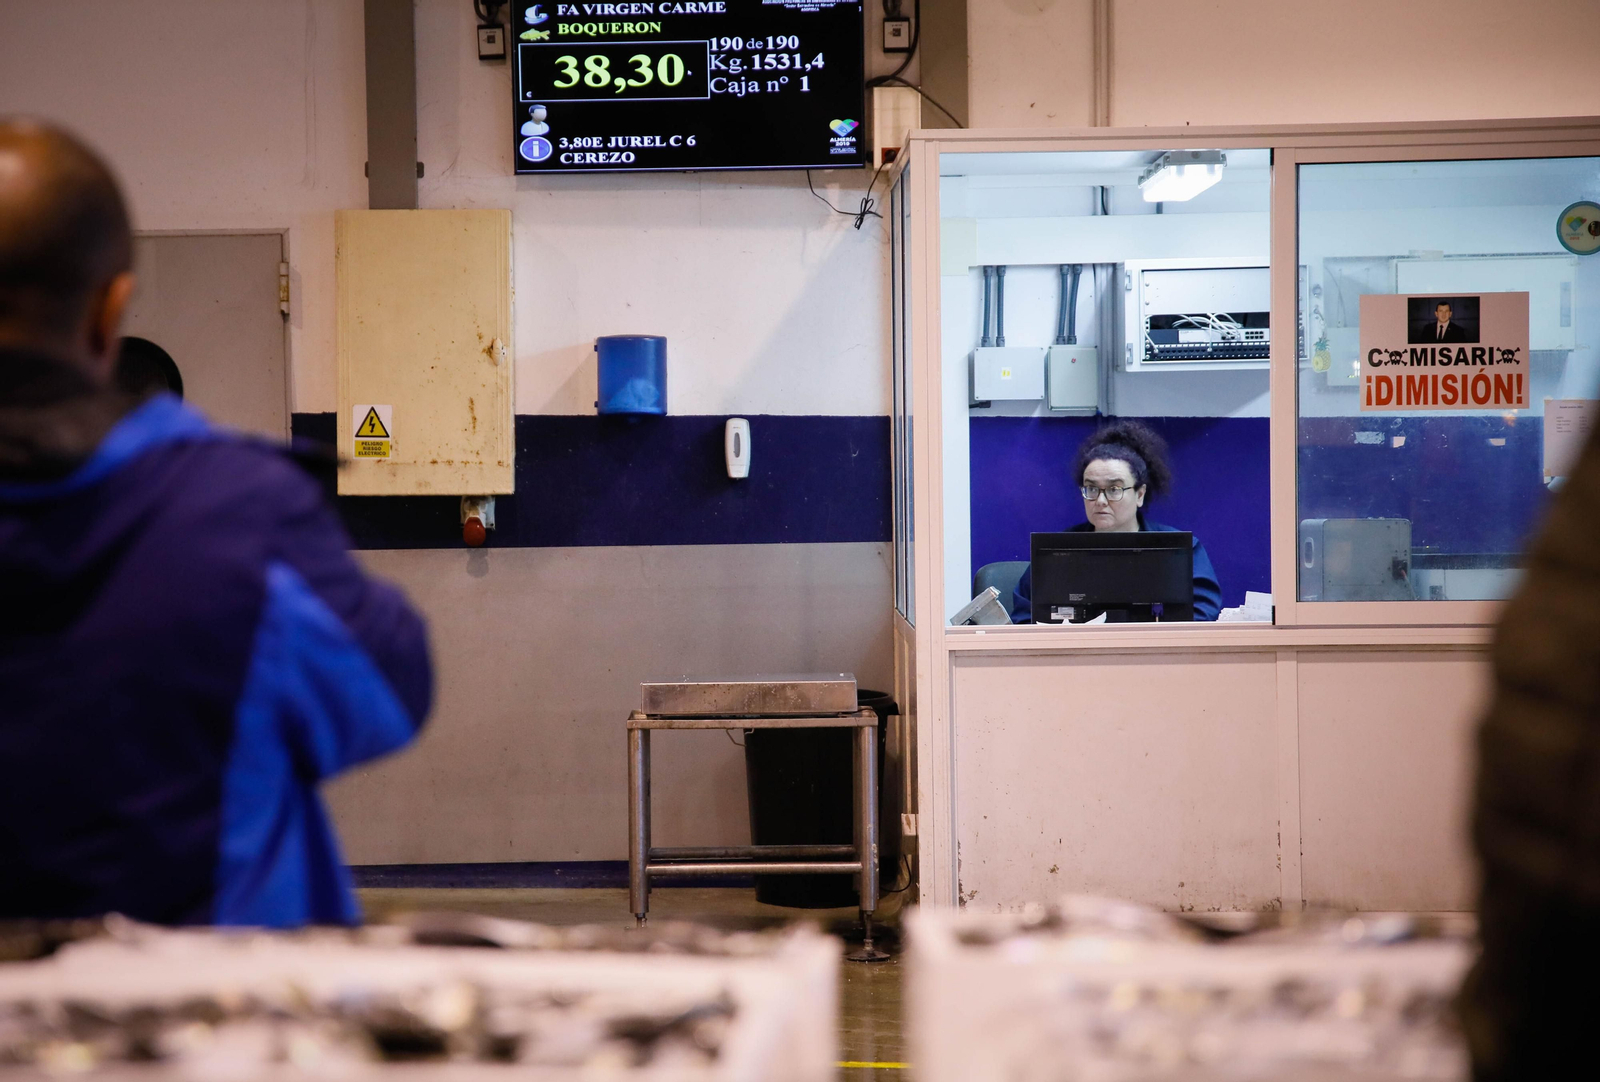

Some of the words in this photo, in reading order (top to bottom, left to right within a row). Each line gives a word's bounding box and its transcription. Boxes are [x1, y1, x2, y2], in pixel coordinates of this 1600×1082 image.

[557, 4, 580, 16] FA
[583, 3, 657, 15] VIRGEN
[660, 1, 726, 14] CARME
[557, 22, 662, 36] BOQUERON
[710, 36, 743, 51] 190
[746, 38, 763, 50] de
[766, 35, 799, 50] 190
[709, 54, 747, 74] Kg.
[752, 52, 825, 71] 1531,4
[553, 53, 685, 94] 38,30
[709, 76, 760, 97] Caja
[799, 75, 810, 92] 1
[559, 137, 602, 150] 3,80E
[607, 136, 664, 149] JUREL
[665, 135, 681, 147] C
[686, 135, 696, 147] 6
[560, 152, 636, 164] CEREZO
[1368, 347, 1520, 367] CMISARI
[1366, 369, 1522, 406] ¡DIMISIÓN!
